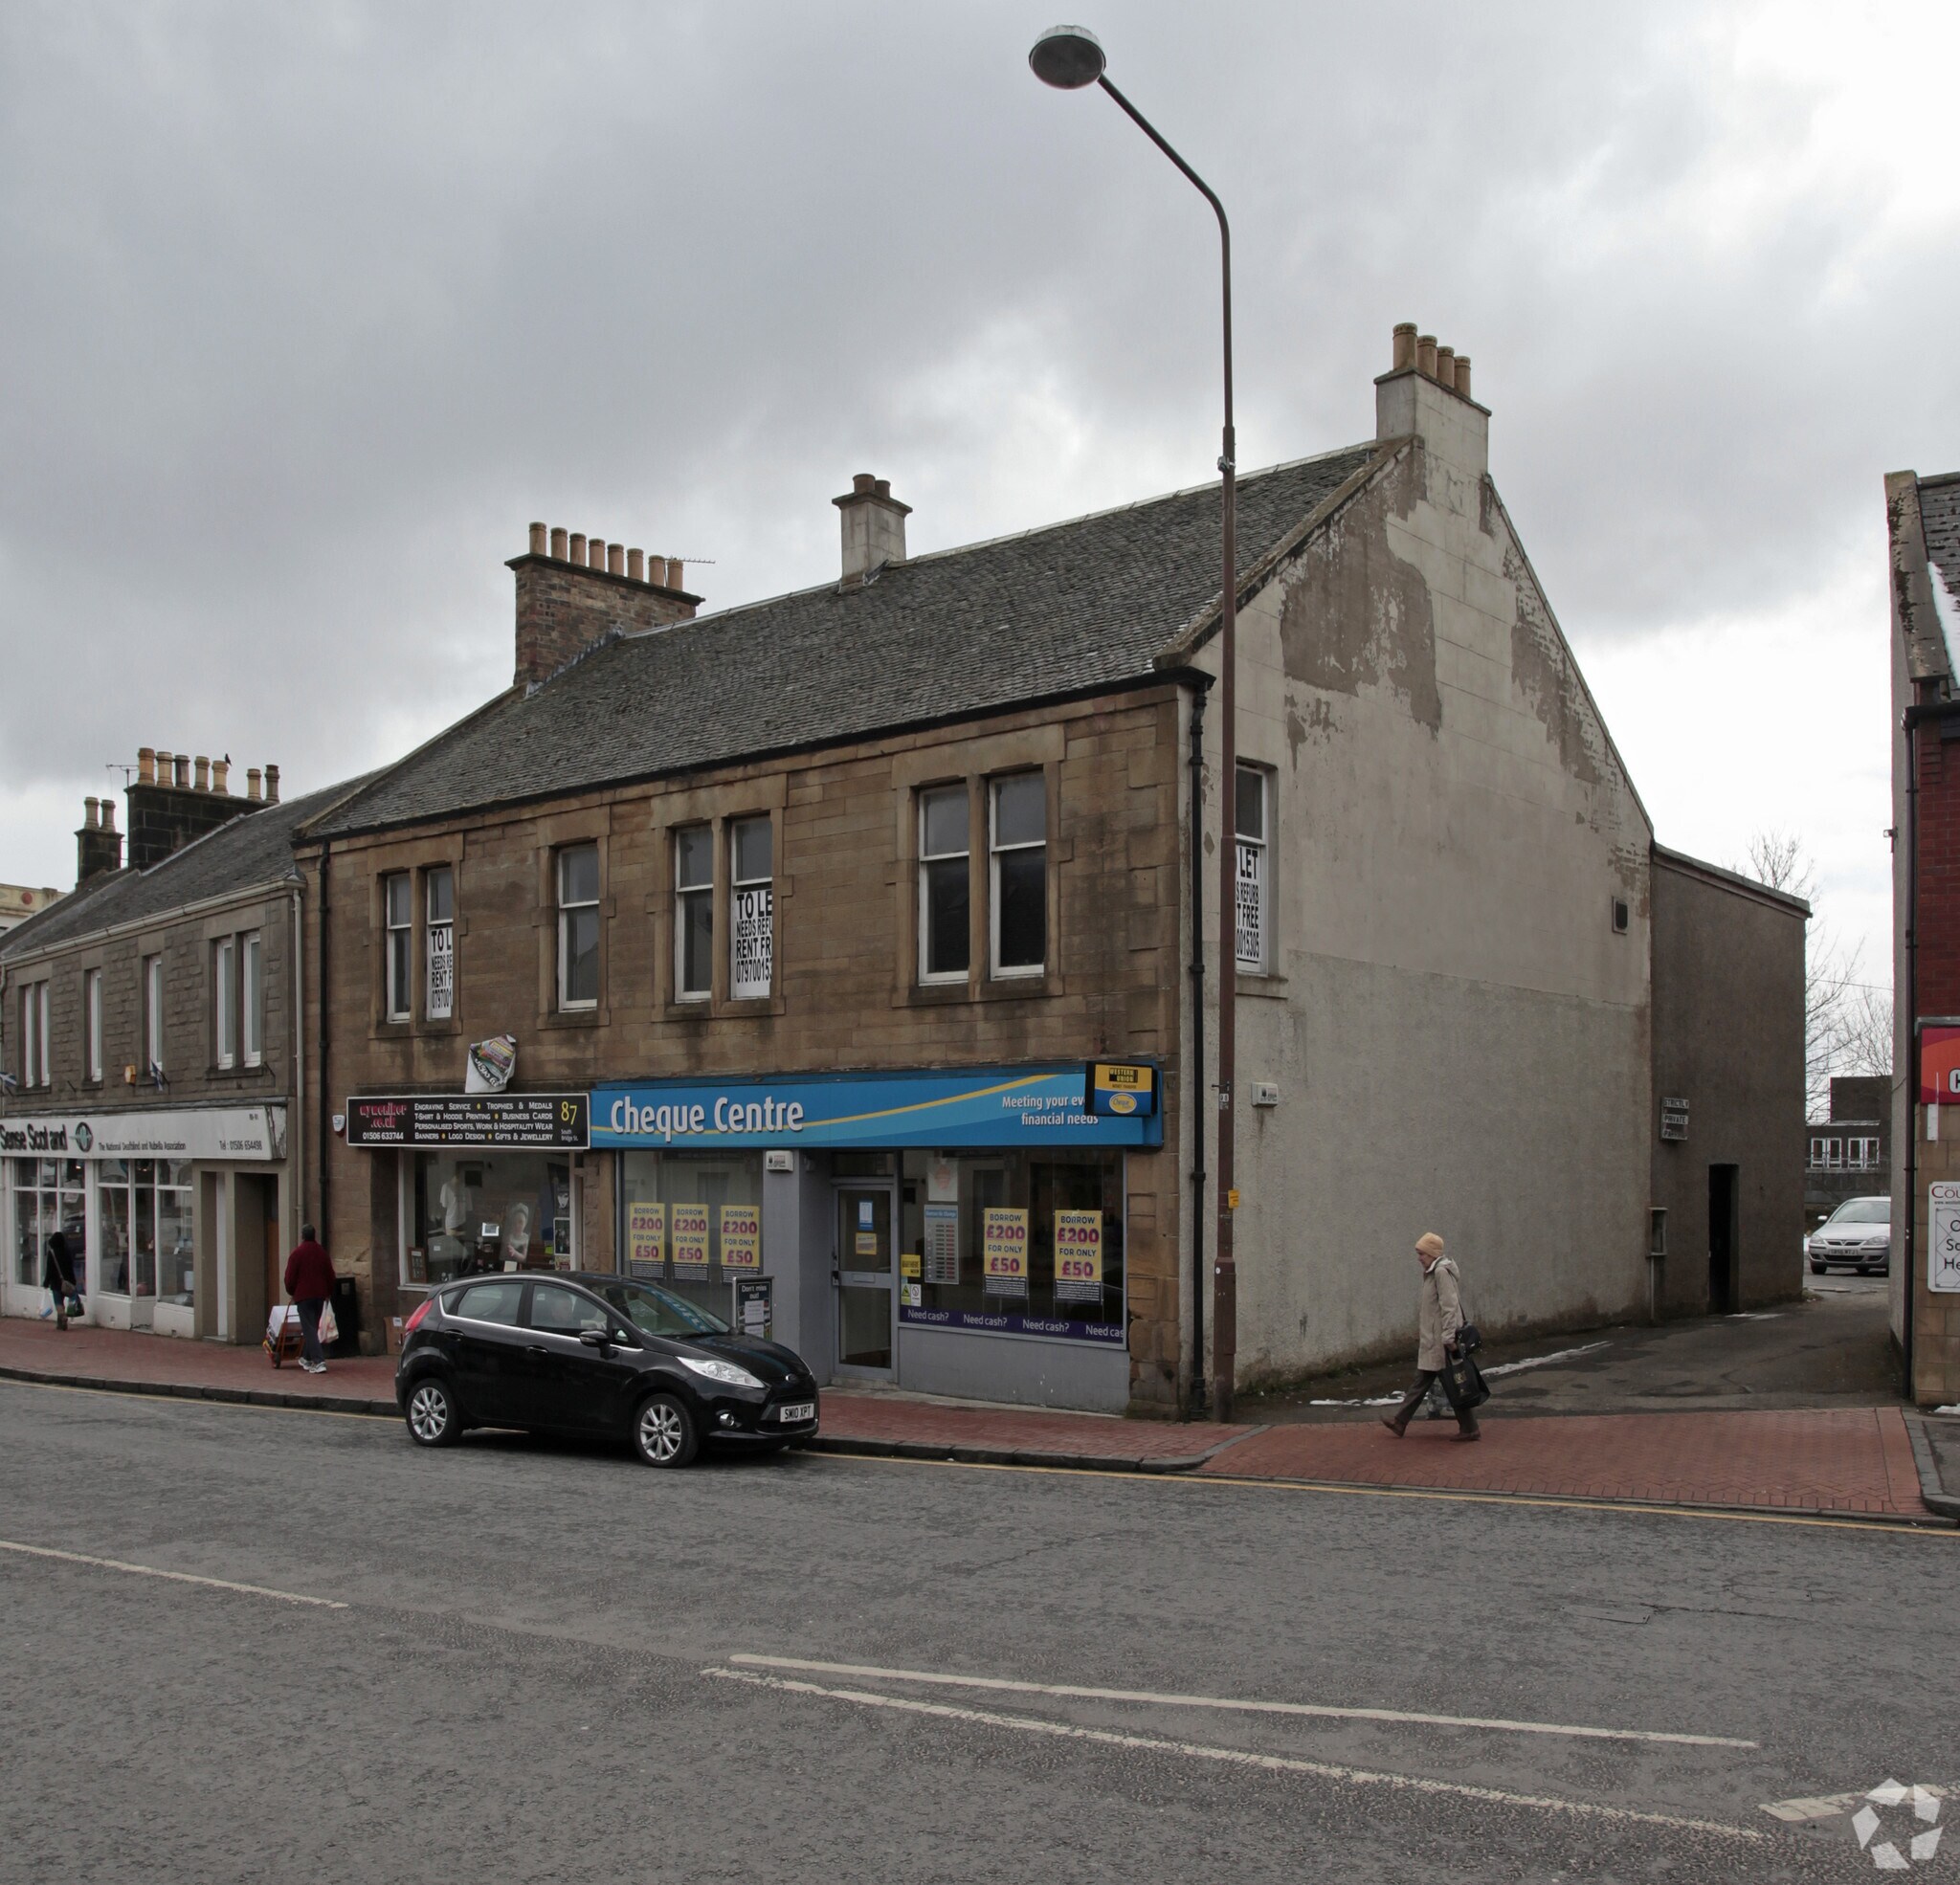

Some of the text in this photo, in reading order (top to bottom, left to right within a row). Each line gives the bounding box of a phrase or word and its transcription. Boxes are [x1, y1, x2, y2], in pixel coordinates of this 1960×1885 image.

[1239, 847, 1258, 879] LET
[737, 892, 754, 920] TO
[1242, 904, 1258, 929] FREE
[736, 920, 756, 938] NEEDS
[432, 929, 444, 952] TO
[736, 938, 758, 959] RENT
[432, 955, 445, 971] NEEDS
[432, 970, 447, 988] RENT
[1002, 1096, 1042, 1110] Meeting
[1045, 1098, 1069, 1110] your
[561, 1101, 577, 1125] 87
[611, 1096, 804, 1142] Cheque Centre
[1021, 1112, 1064, 1125] financial
[1664, 1115, 1686, 1123] PRIVATE
[0, 1123, 27, 1150] Sense
[632, 1217, 662, 1230] £200
[990, 1213, 1022, 1222] BORROW
[674, 1219, 706, 1231] £200
[723, 1221, 757, 1234] £200
[986, 1225, 1025, 1240] £200
[1058, 1228, 1099, 1244] £200
[635, 1245, 658, 1258] £50
[679, 1247, 702, 1260] £50
[1004, 1245, 1022, 1253] ONLY
[1058, 1248, 1097, 1257] FOR ONLY
[727, 1250, 753, 1263] £50
[991, 1257, 1020, 1274] £50
[1061, 1261, 1094, 1277] £50
[907, 1308, 948, 1322] Need cash?
[963, 1314, 1008, 1327] Need cash?
[1022, 1319, 1069, 1333] Need cash?
[1085, 1324, 1108, 1336] Need
